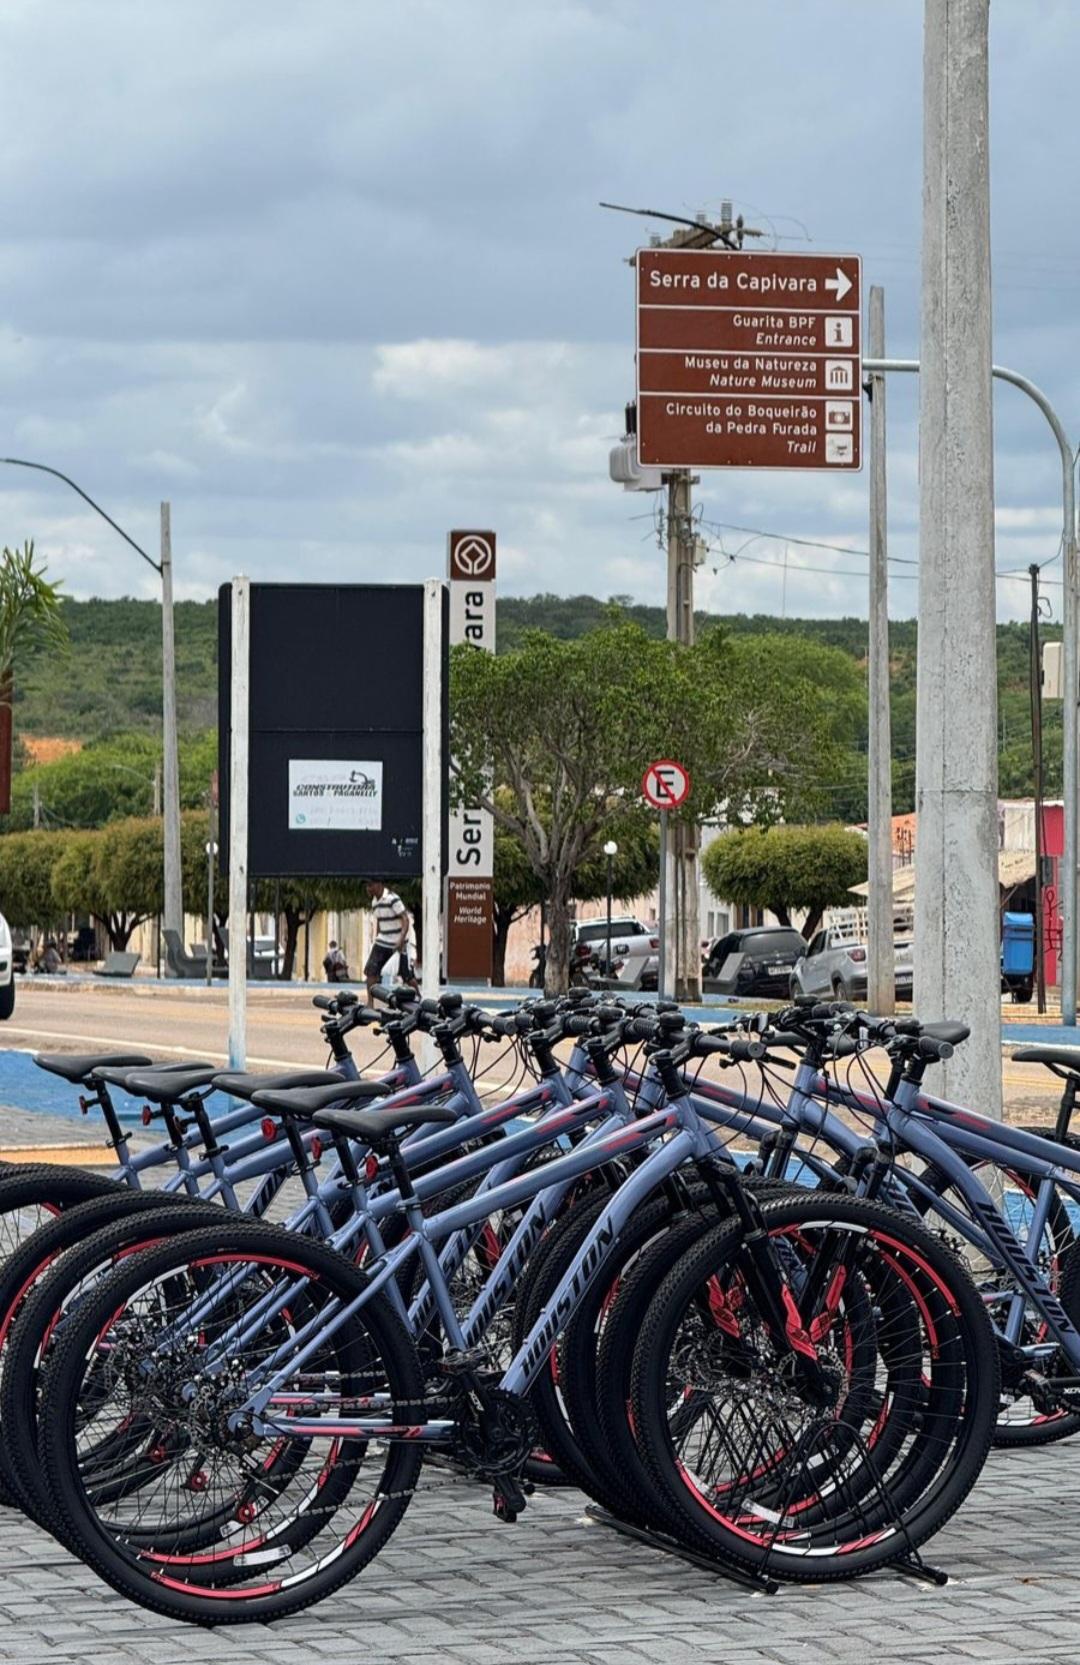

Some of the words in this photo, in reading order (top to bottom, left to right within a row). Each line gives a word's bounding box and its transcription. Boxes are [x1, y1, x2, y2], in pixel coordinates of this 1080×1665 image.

[650, 270, 700, 288] Serra
[707, 272, 729, 289] da
[736, 272, 817, 293] Capivara
[733, 314, 784, 328] Guarita
[789, 316, 816, 329] BPF
[756, 332, 817, 346] Entrance
[685, 356, 728, 369] Museu
[733, 357, 750, 369] da
[755, 357, 817, 372] Natureza
[709, 374, 756, 387] Nature
[761, 375, 817, 388] Museum
[666, 402, 721, 416] Circuito
[725, 404, 742, 417] do
[748, 404, 817, 419] Boqueirão
[706, 421, 722, 433] da
[727, 421, 767, 434] Pedra
[772, 422, 817, 436] Furada
[787, 440, 816, 453] Trail
[656, 770, 675, 798] E
[455, 891, 487, 901] Mundial
[459, 906, 482, 915] World
[454, 914, 487, 925] Heritage
[976, 1202, 1075, 1334] HOUSTON
[520, 1215, 614, 1378] HOUSTON
